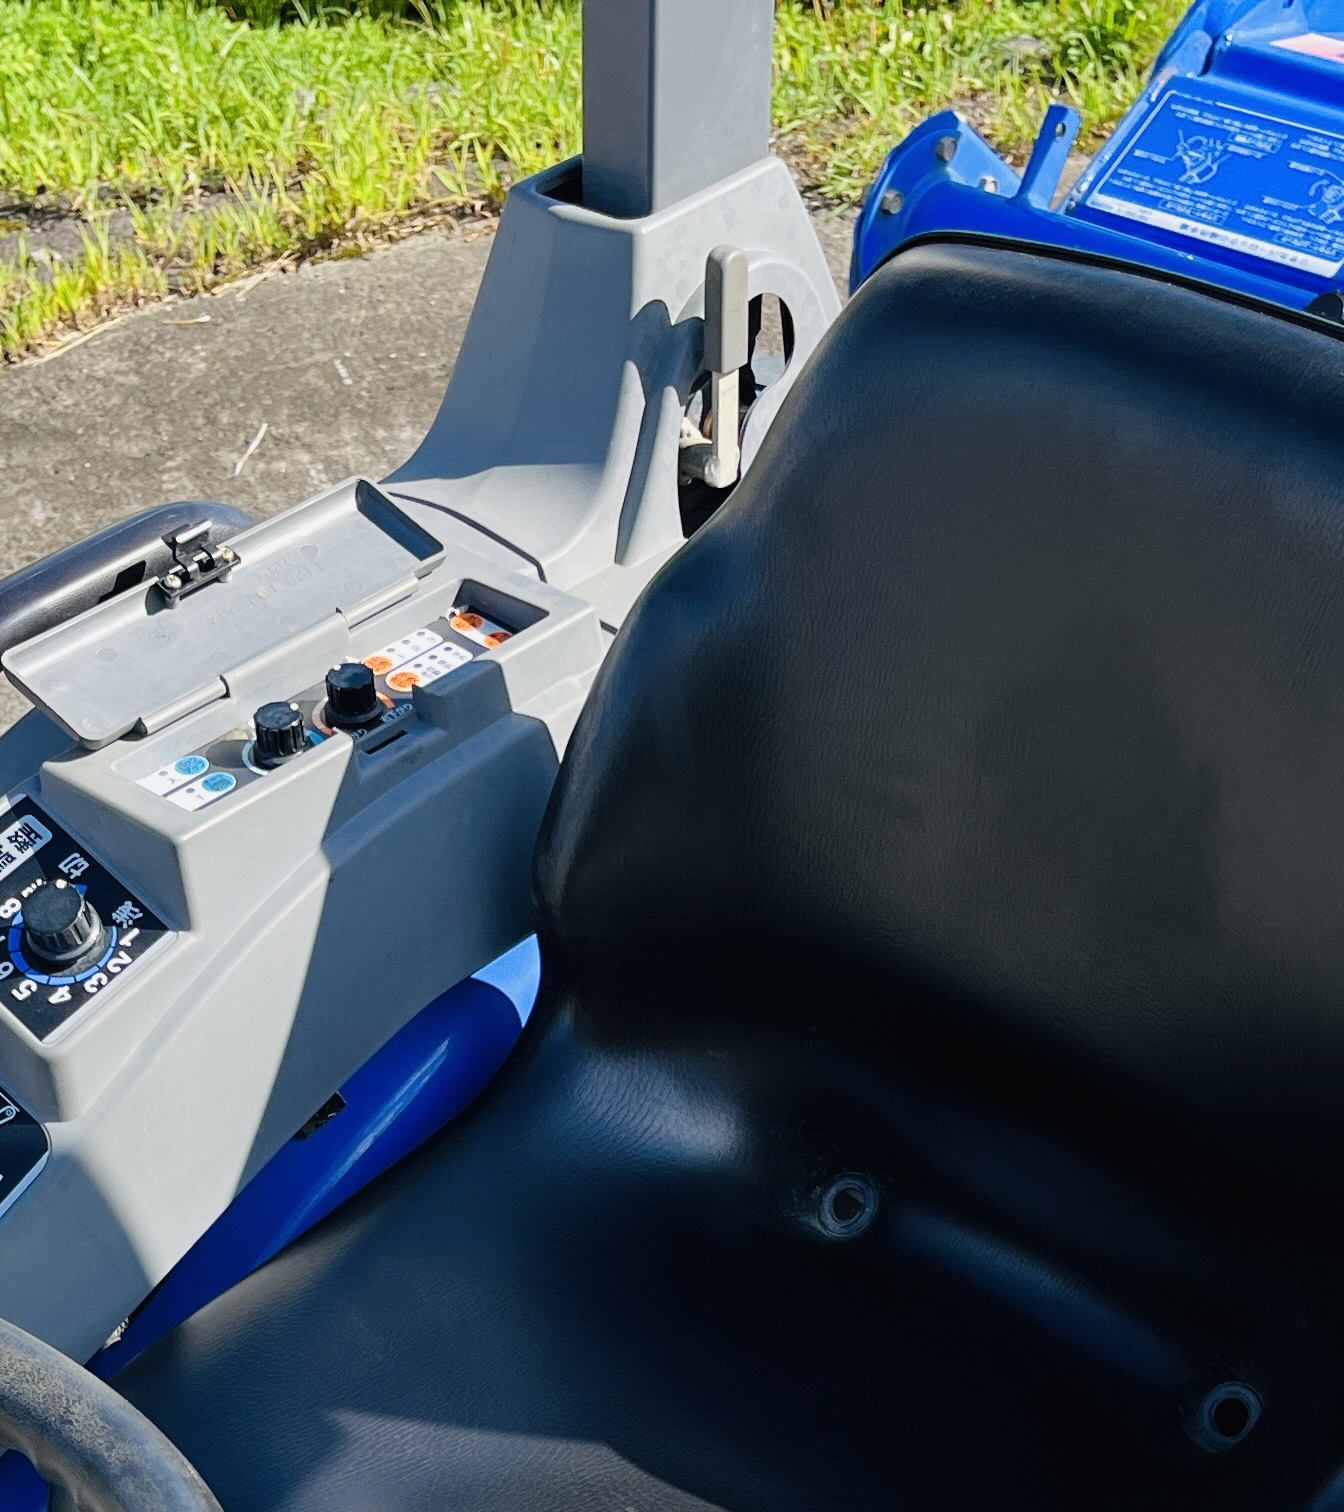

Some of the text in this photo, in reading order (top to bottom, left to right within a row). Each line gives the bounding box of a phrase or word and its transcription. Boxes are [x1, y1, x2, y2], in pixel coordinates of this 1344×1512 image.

[58, 853, 90, 879] 切
[119, 927, 140, 947] 1
[107, 951, 132, 973] 2
[12, 980, 38, 1001] 5
[84, 973, 107, 994] 3
[48, 986, 72, 1005] 4
